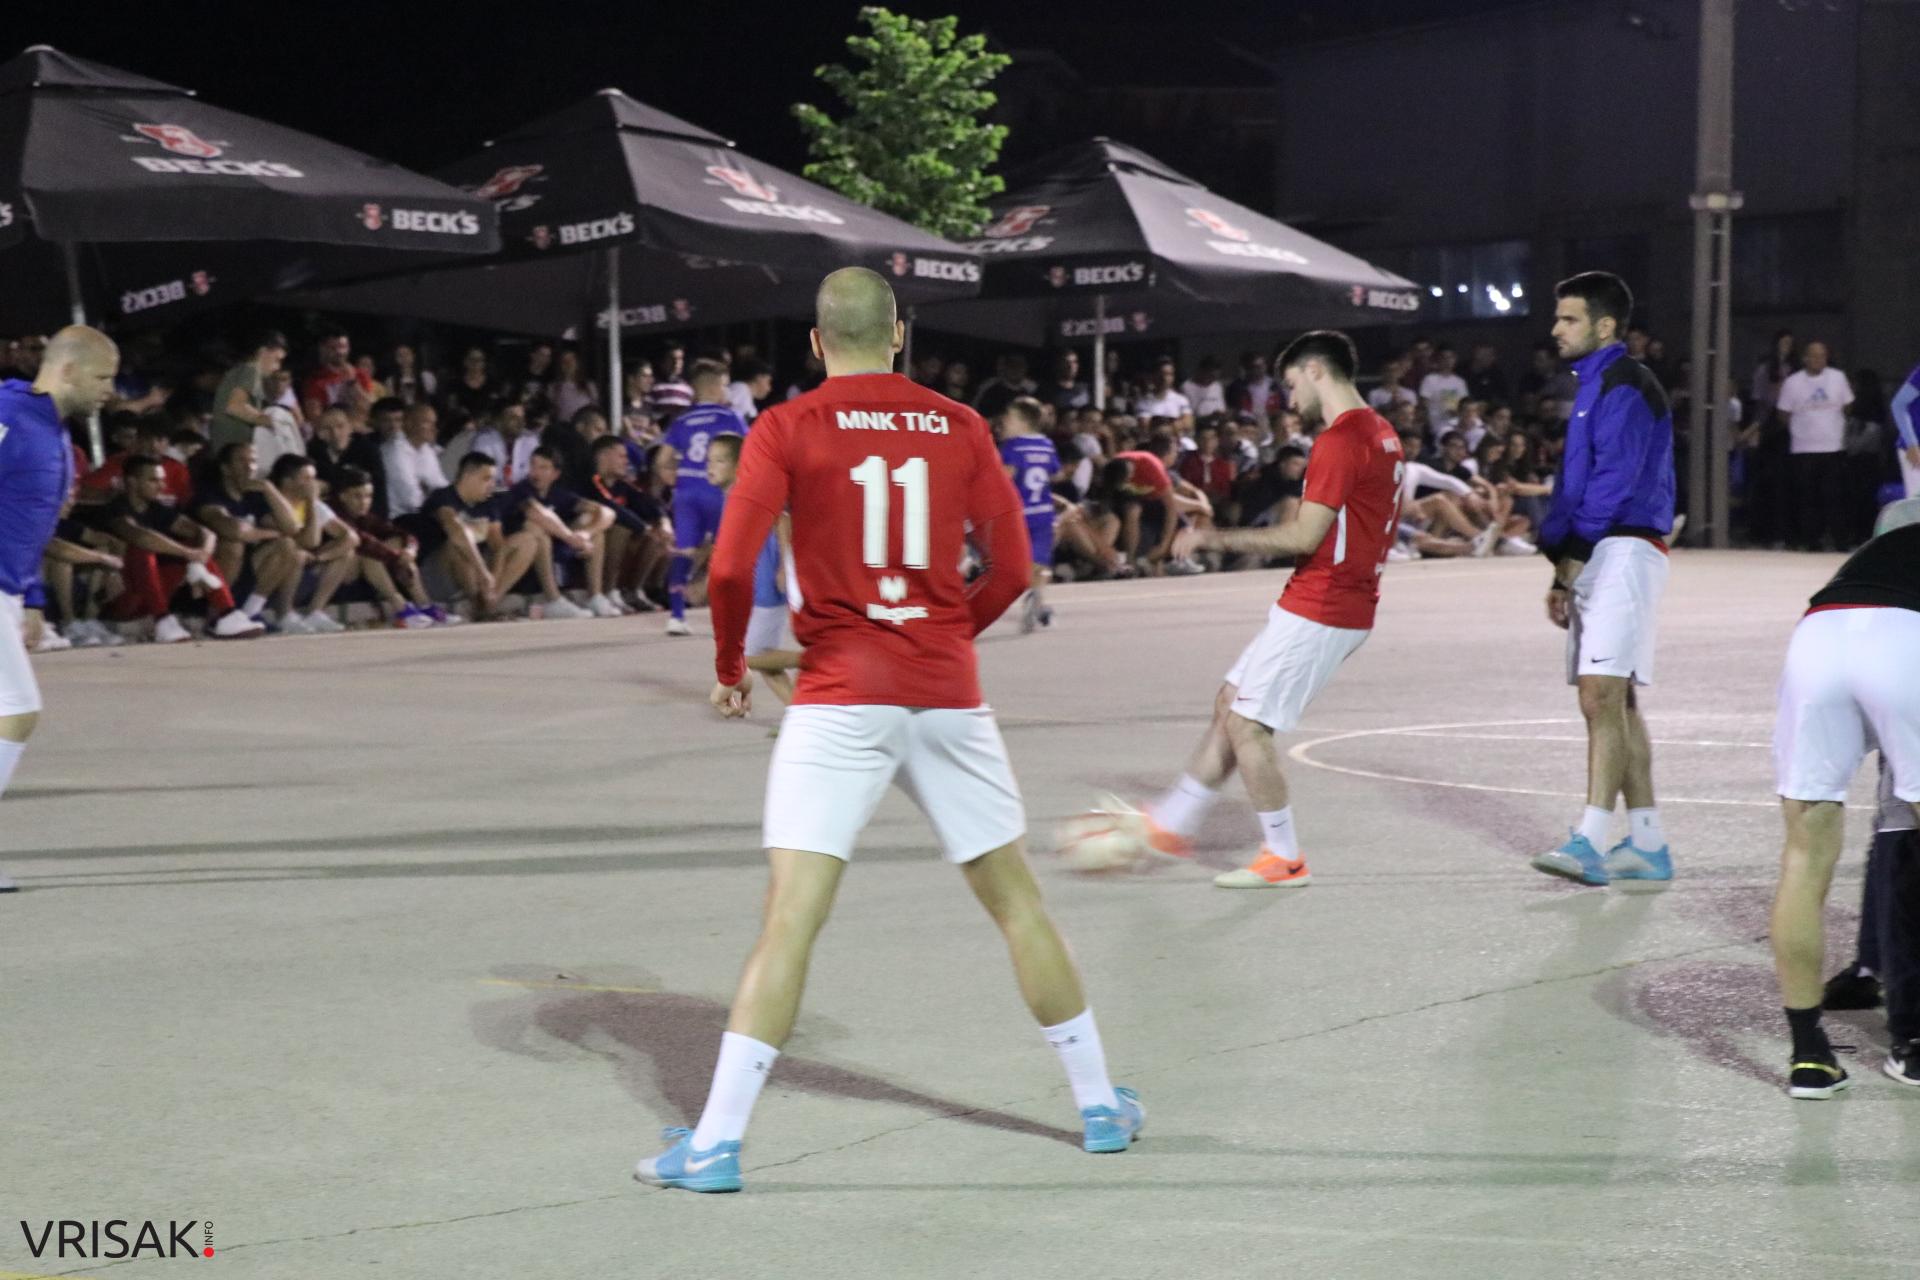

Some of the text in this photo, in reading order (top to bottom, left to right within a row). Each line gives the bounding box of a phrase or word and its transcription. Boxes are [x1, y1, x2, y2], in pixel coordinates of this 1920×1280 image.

[392, 209, 480, 235] BECK'S
[559, 212, 635, 244] BECK'S
[914, 258, 980, 282] BECK'S
[1074, 262, 1144, 285] BECK'S
[835, 410, 950, 435] MNK TIĆI
[688, 431, 710, 463] 8
[849, 455, 930, 570] 11
